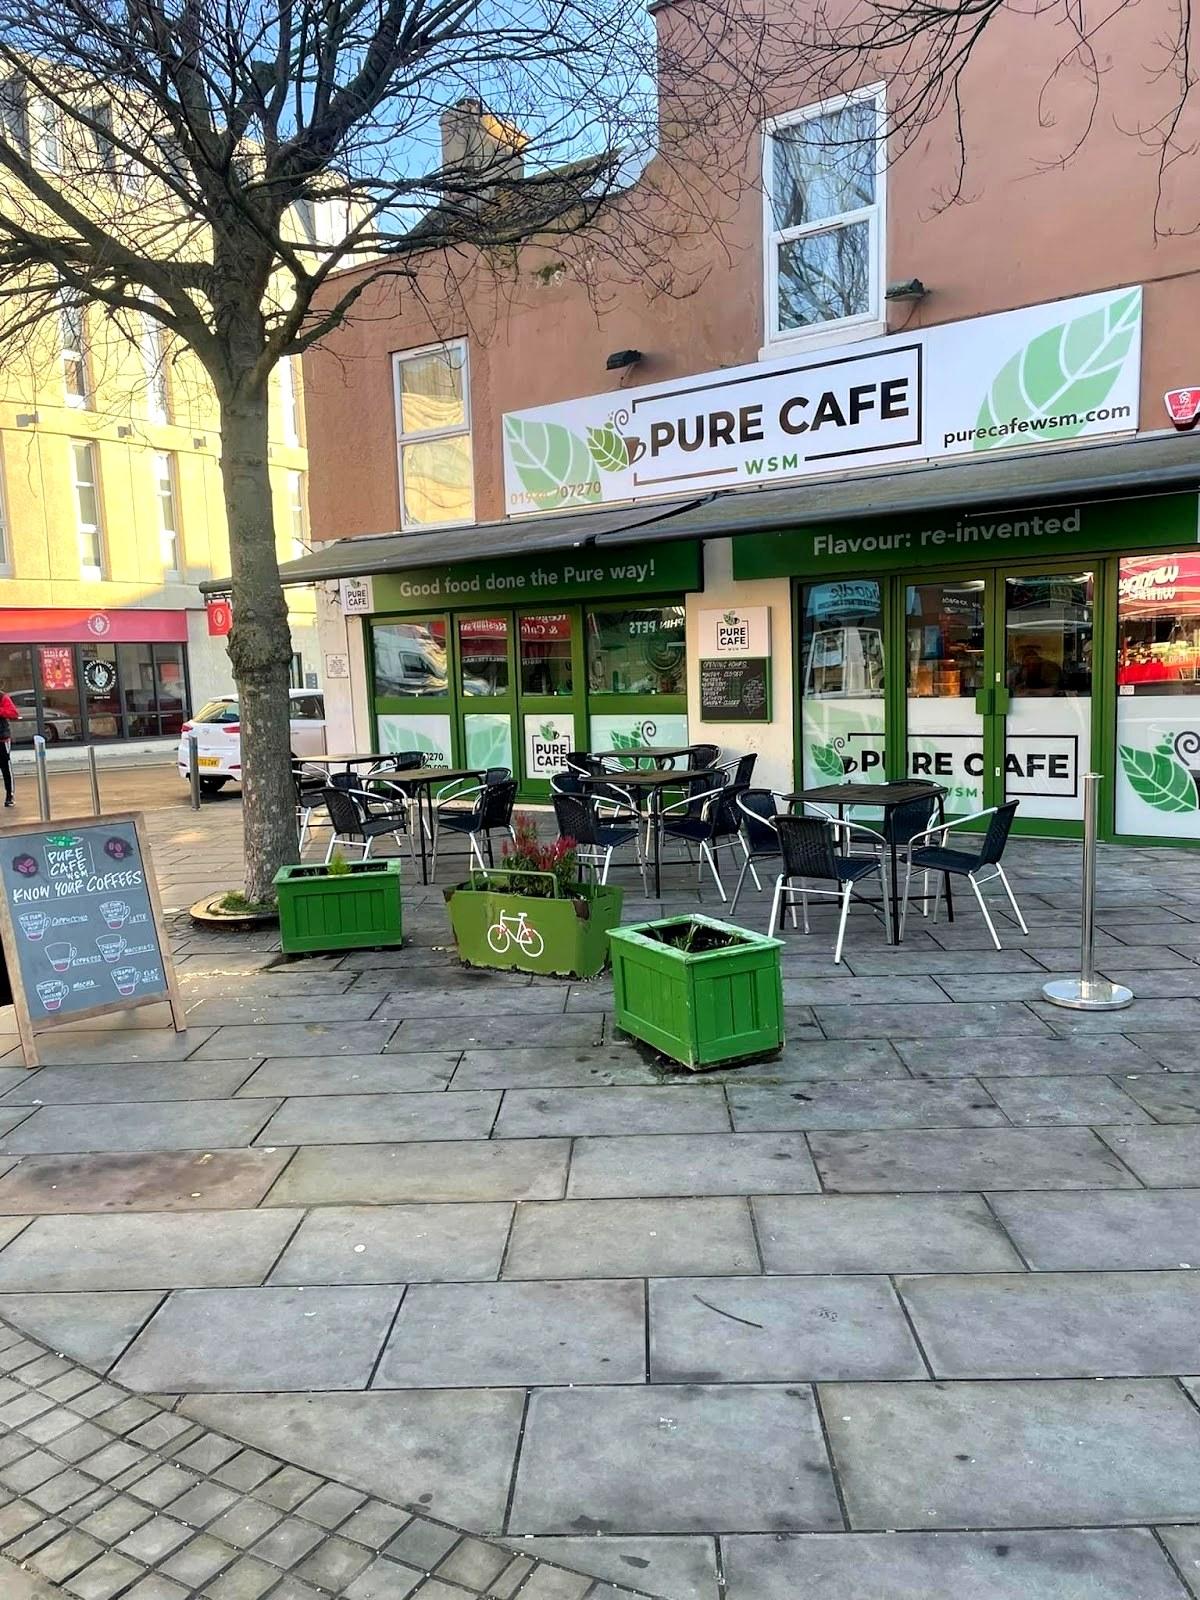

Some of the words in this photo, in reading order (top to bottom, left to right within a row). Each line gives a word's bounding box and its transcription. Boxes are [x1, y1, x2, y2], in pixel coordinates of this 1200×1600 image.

[651, 404, 764, 457] PURE
[779, 378, 909, 434] CAFE
[943, 405, 1131, 448] purecafewsm.com
[744, 454, 798, 475] WSM
[813, 533, 911, 556] Flavour:
[921, 509, 1081, 546] re-invented
[400, 579, 440, 597] Good
[444, 575, 480, 593] food
[485, 573, 525, 590] done
[530, 568, 559, 586] the
[564, 566, 604, 583] Pure
[610, 558, 656, 582] way!
[347, 589, 367, 598] PURE
[720, 627, 746, 636] PURE
[720, 637, 746, 645] CAFE
[536, 744, 567, 754] PURE
[537, 755, 567, 766] CAFE
[48, 847, 84, 863] PURE
[50, 858, 87, 876] CAFE
[13, 885, 50, 903] KNOW
[55, 880, 84, 897] YOUR
[87, 871, 142, 892] COFFEES
